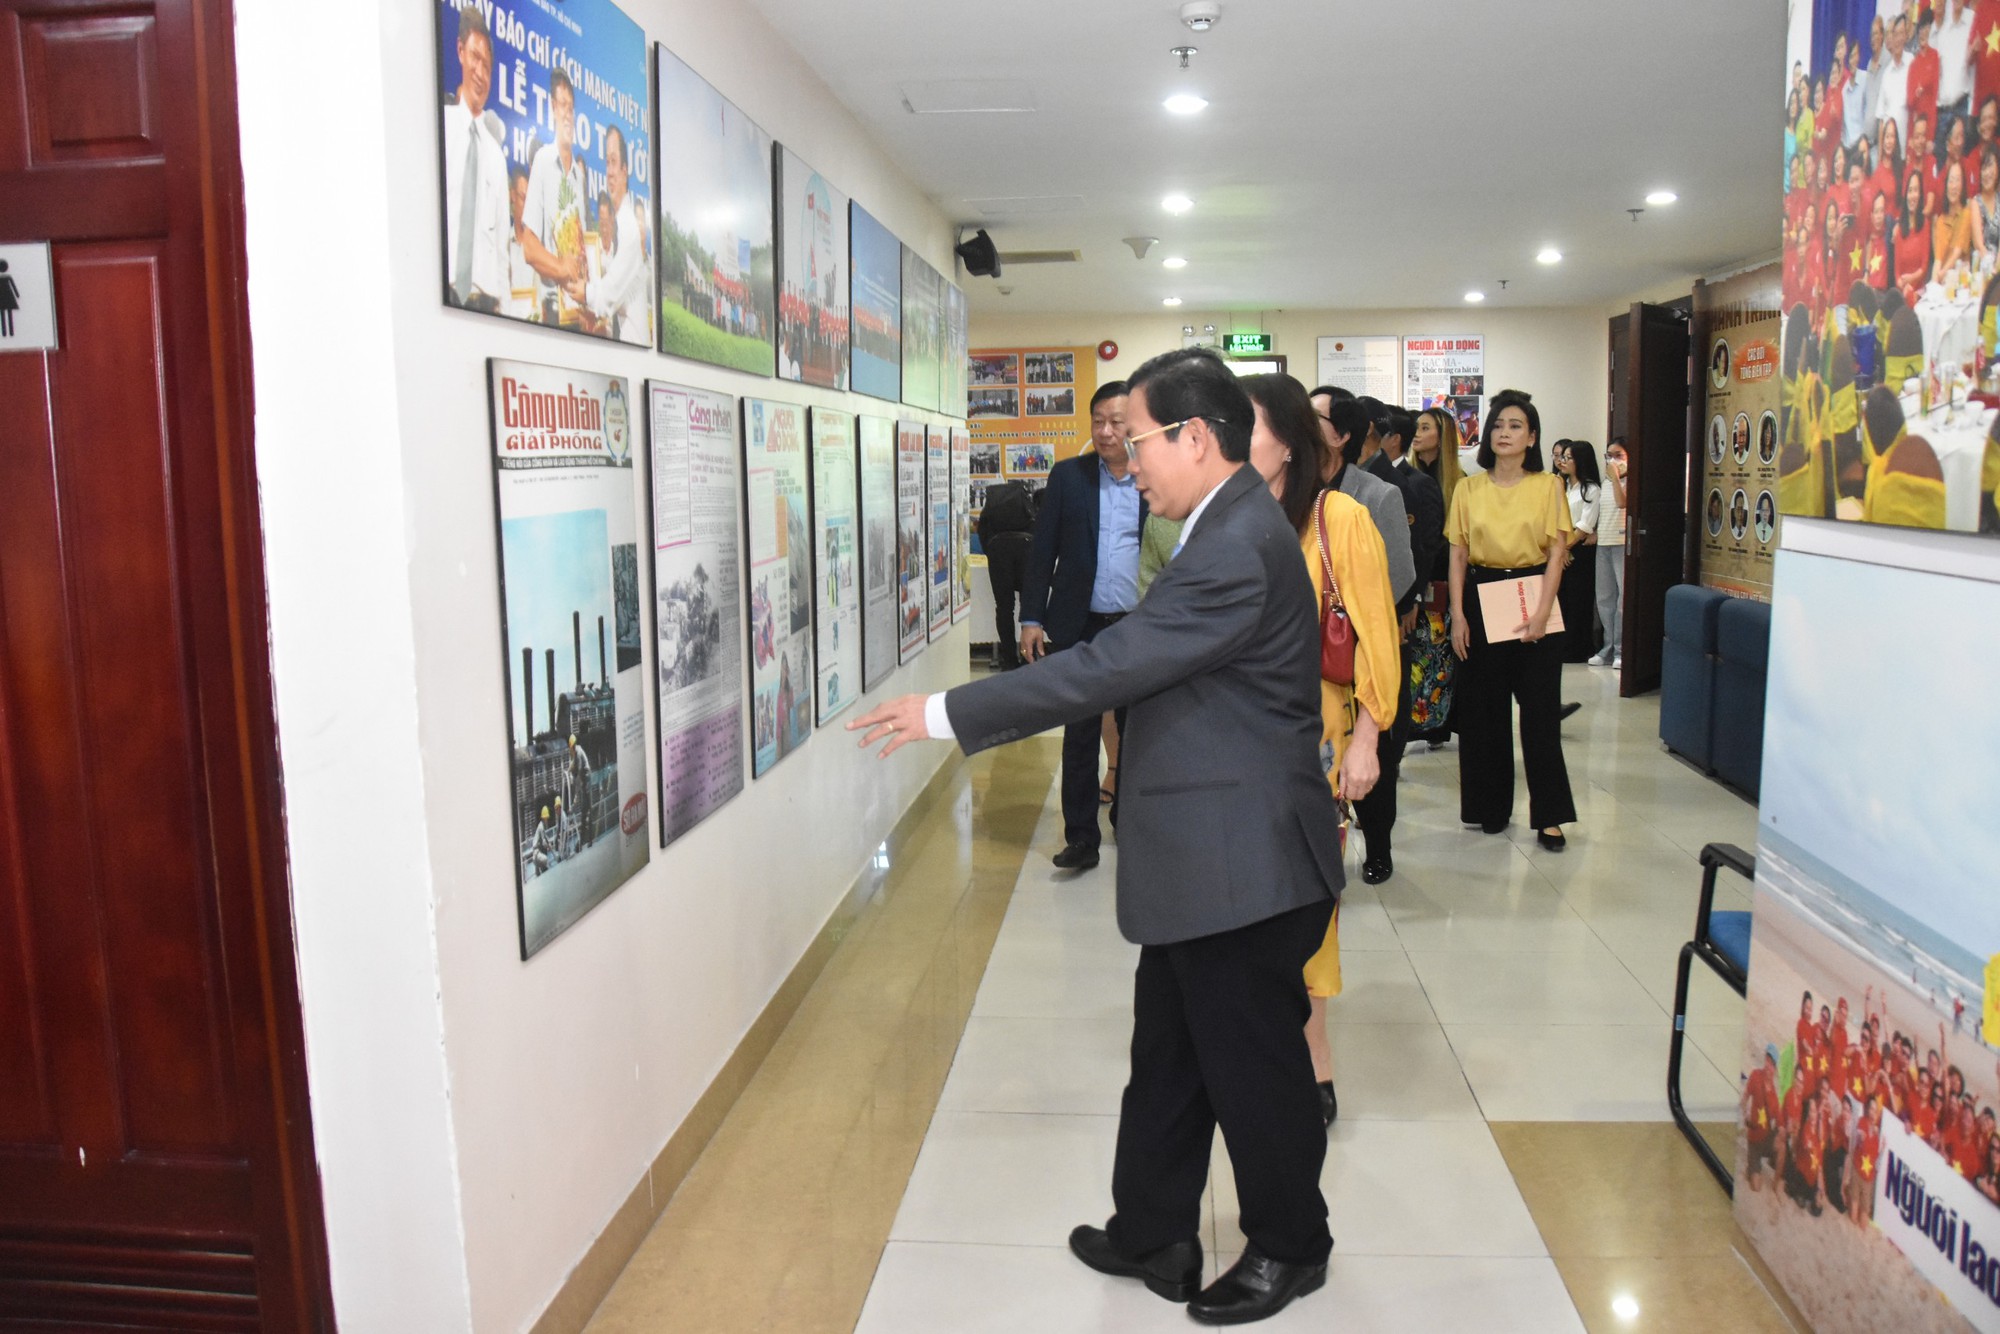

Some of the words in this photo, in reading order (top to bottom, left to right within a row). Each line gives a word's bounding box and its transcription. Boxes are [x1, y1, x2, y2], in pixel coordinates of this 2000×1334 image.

[495, 6, 525, 52] BÁO
[528, 30, 550, 69] CHÍ
[552, 47, 582, 91] CÁCH
[584, 68, 616, 112] MẠNG
[617, 89, 639, 131] VIỆT
[498, 59, 527, 116] LỄ
[1233, 335, 1261, 344] EXIT
[1407, 340, 1434, 350] NGƯỜI
[1437, 340, 1453, 350] LAO
[1456, 339, 1480, 351] ĐỘNG
[502, 376, 557, 434] Công
[557, 383, 601, 431] nhân
[1884, 1149, 1958, 1265] Người
